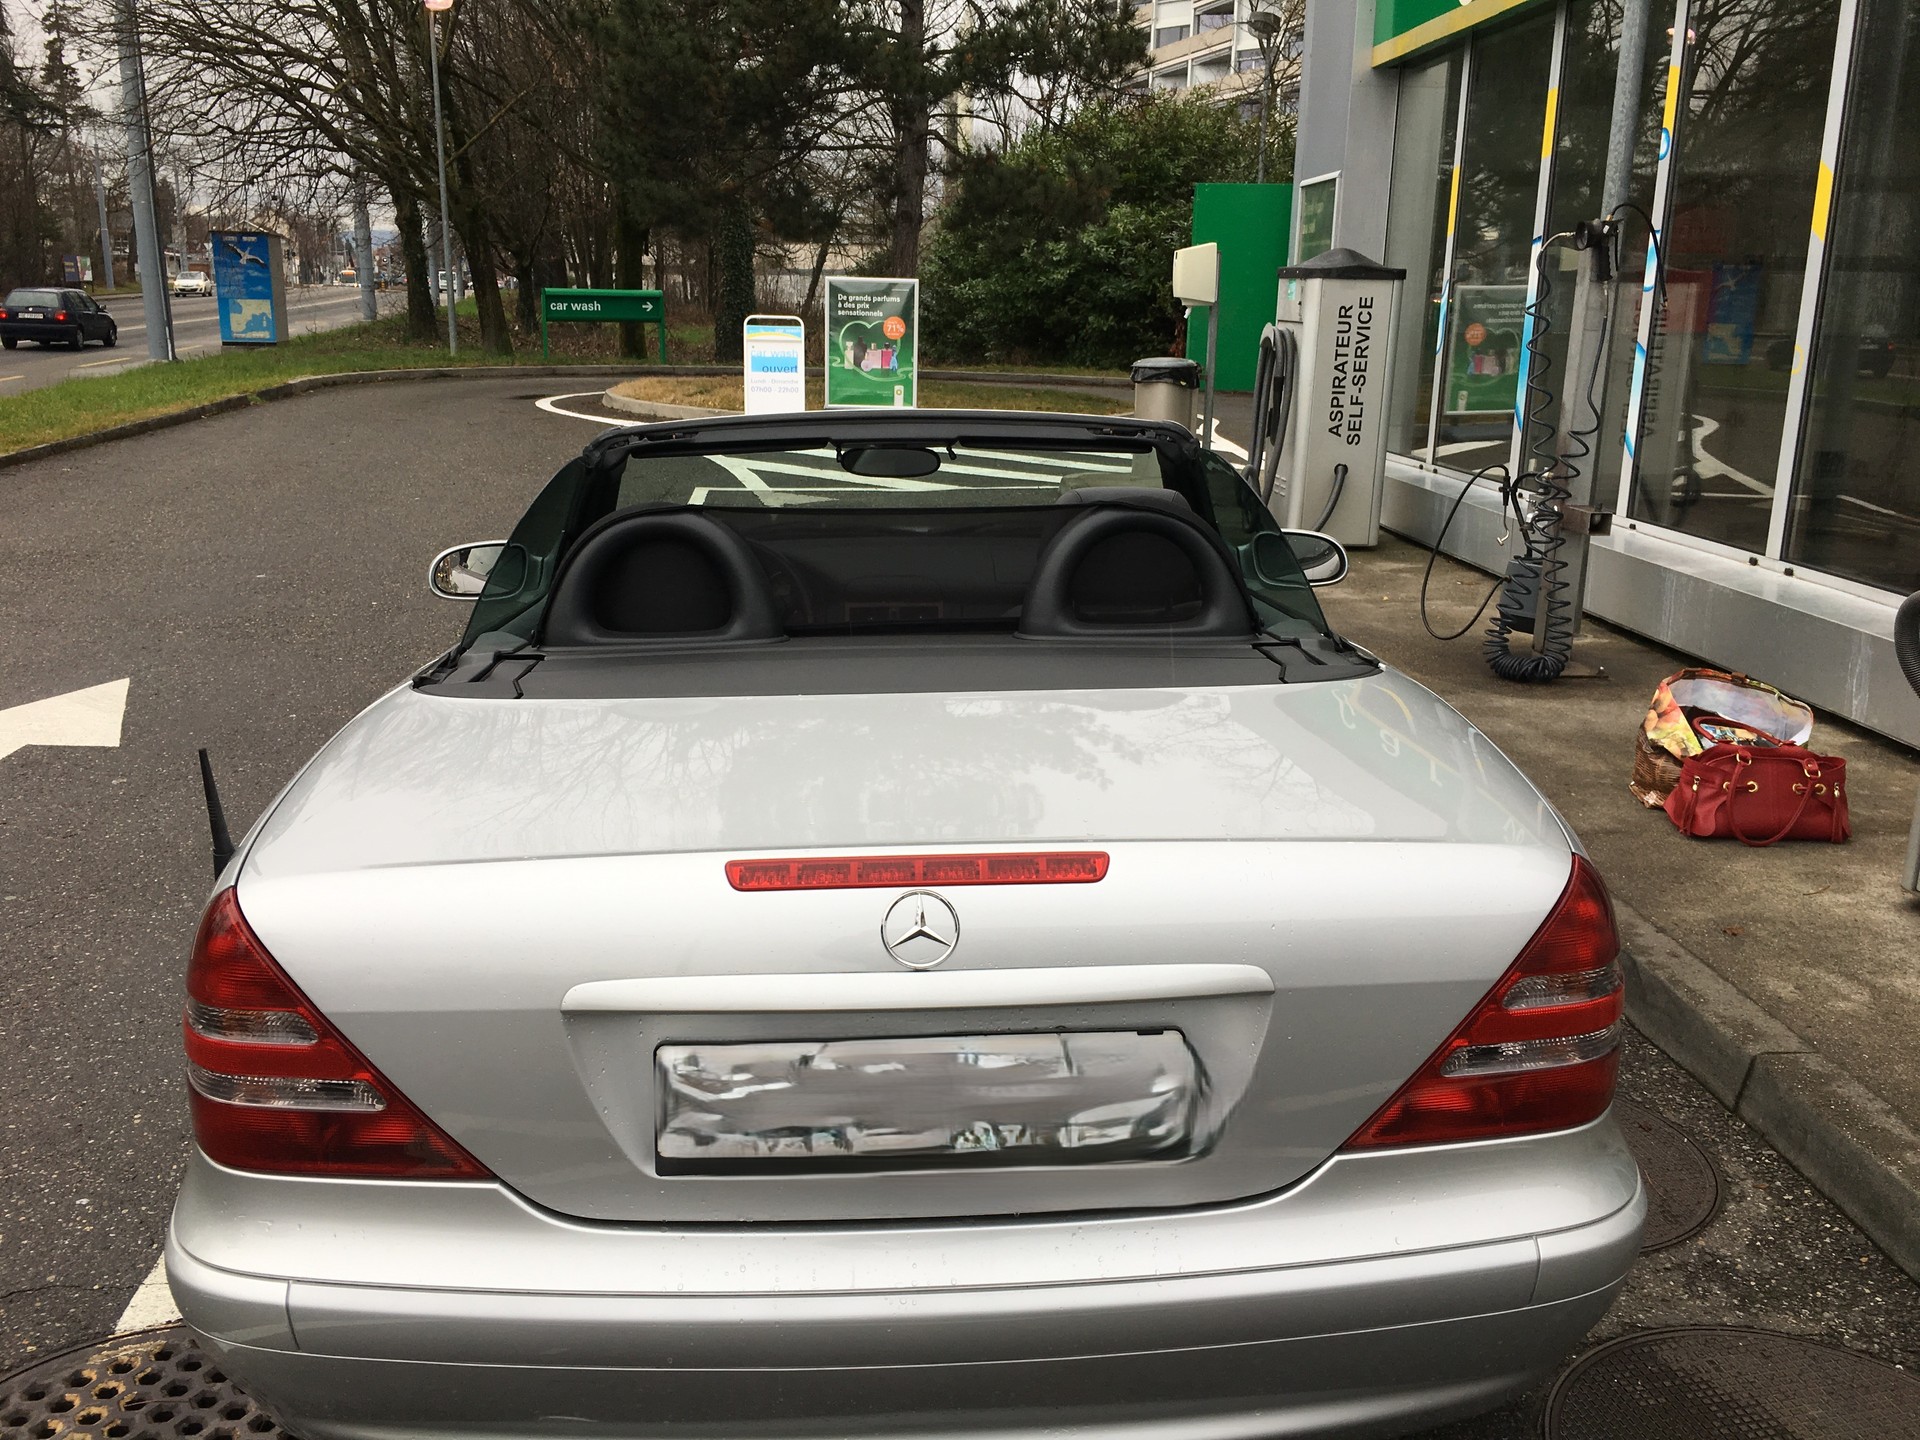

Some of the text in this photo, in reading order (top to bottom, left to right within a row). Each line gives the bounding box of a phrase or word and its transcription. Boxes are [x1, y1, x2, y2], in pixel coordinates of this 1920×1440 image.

[848, 294, 872, 302] grands
[872, 295, 901, 303] parfums
[550, 301, 601, 311] car wash
[762, 365, 798, 373] ouvert
[1328, 305, 1353, 438] ASPIRATEUR
[1346, 296, 1374, 446] SELF-SERVICE
